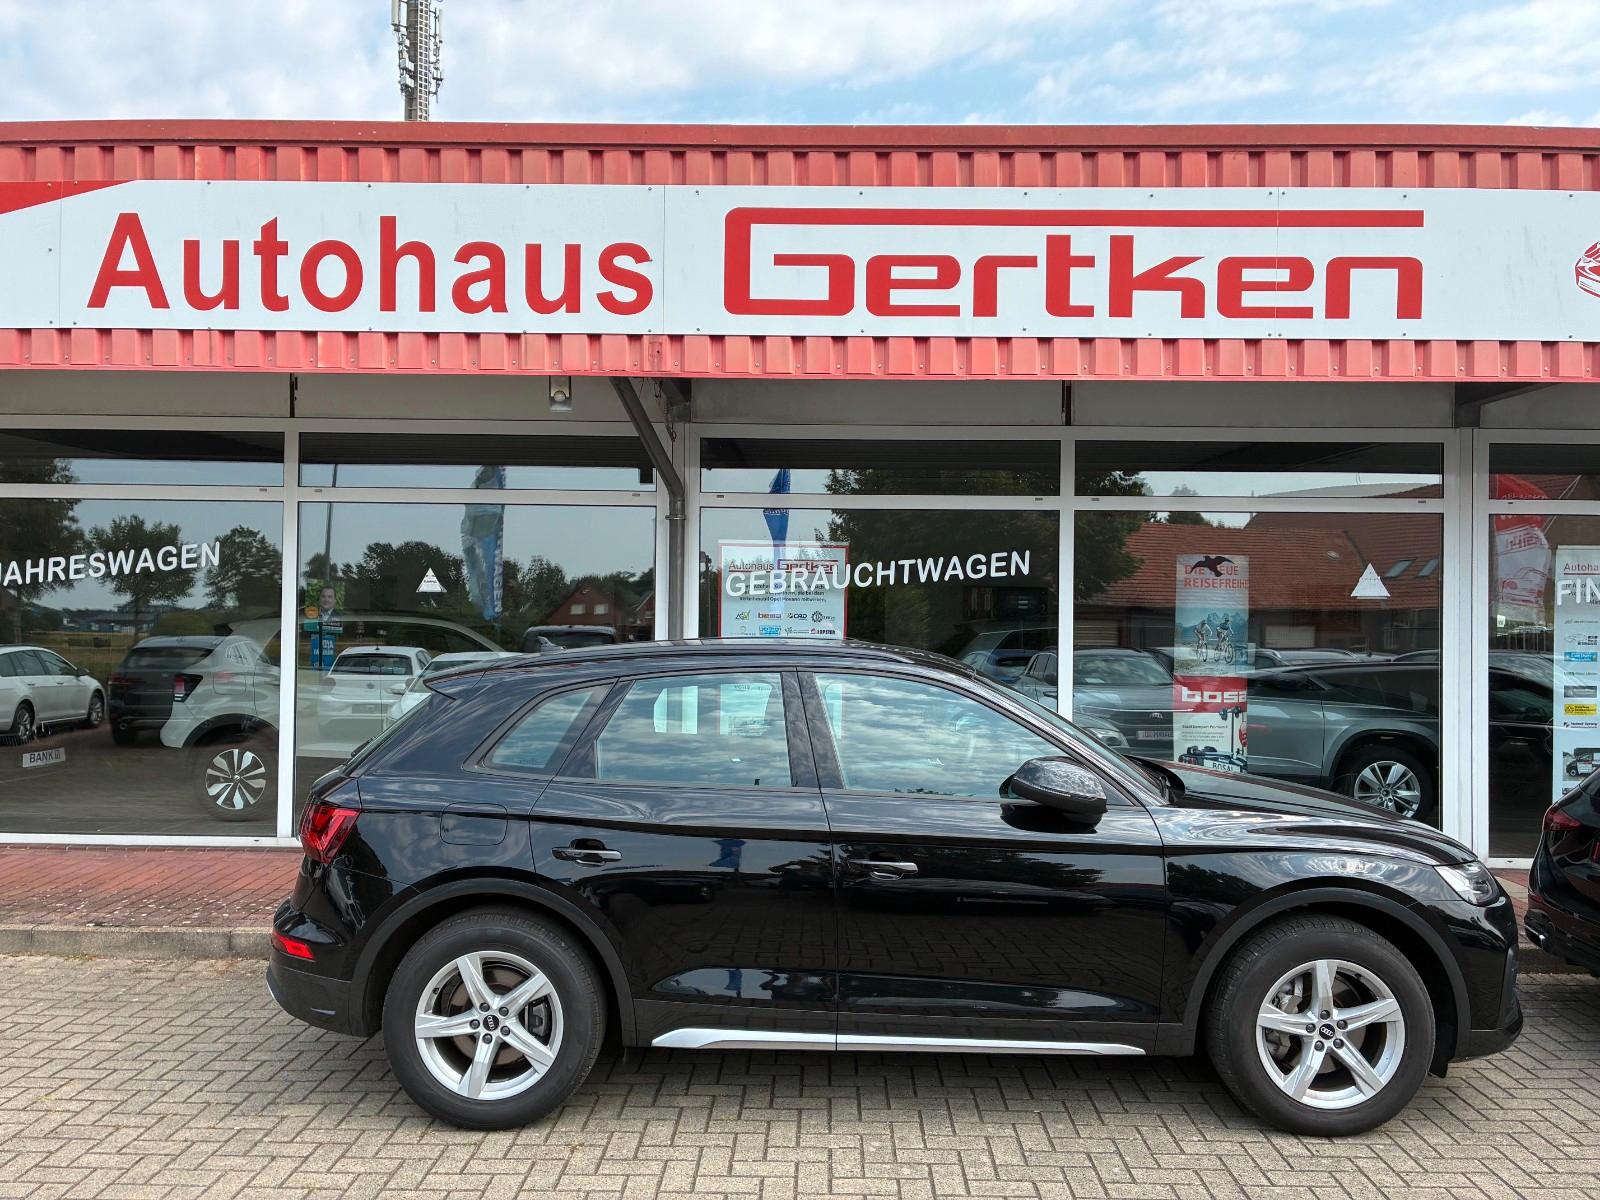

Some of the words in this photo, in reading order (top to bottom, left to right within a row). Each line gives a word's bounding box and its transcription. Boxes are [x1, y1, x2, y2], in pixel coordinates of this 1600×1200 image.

[86, 212, 654, 315] Autohaus
[724, 207, 1425, 320] Gertken
[0, 541, 221, 588] AHRESWAGEN
[725, 550, 1031, 597] GEBRAUCHTWAGEN
[729, 560, 775, 571] Autohaus
